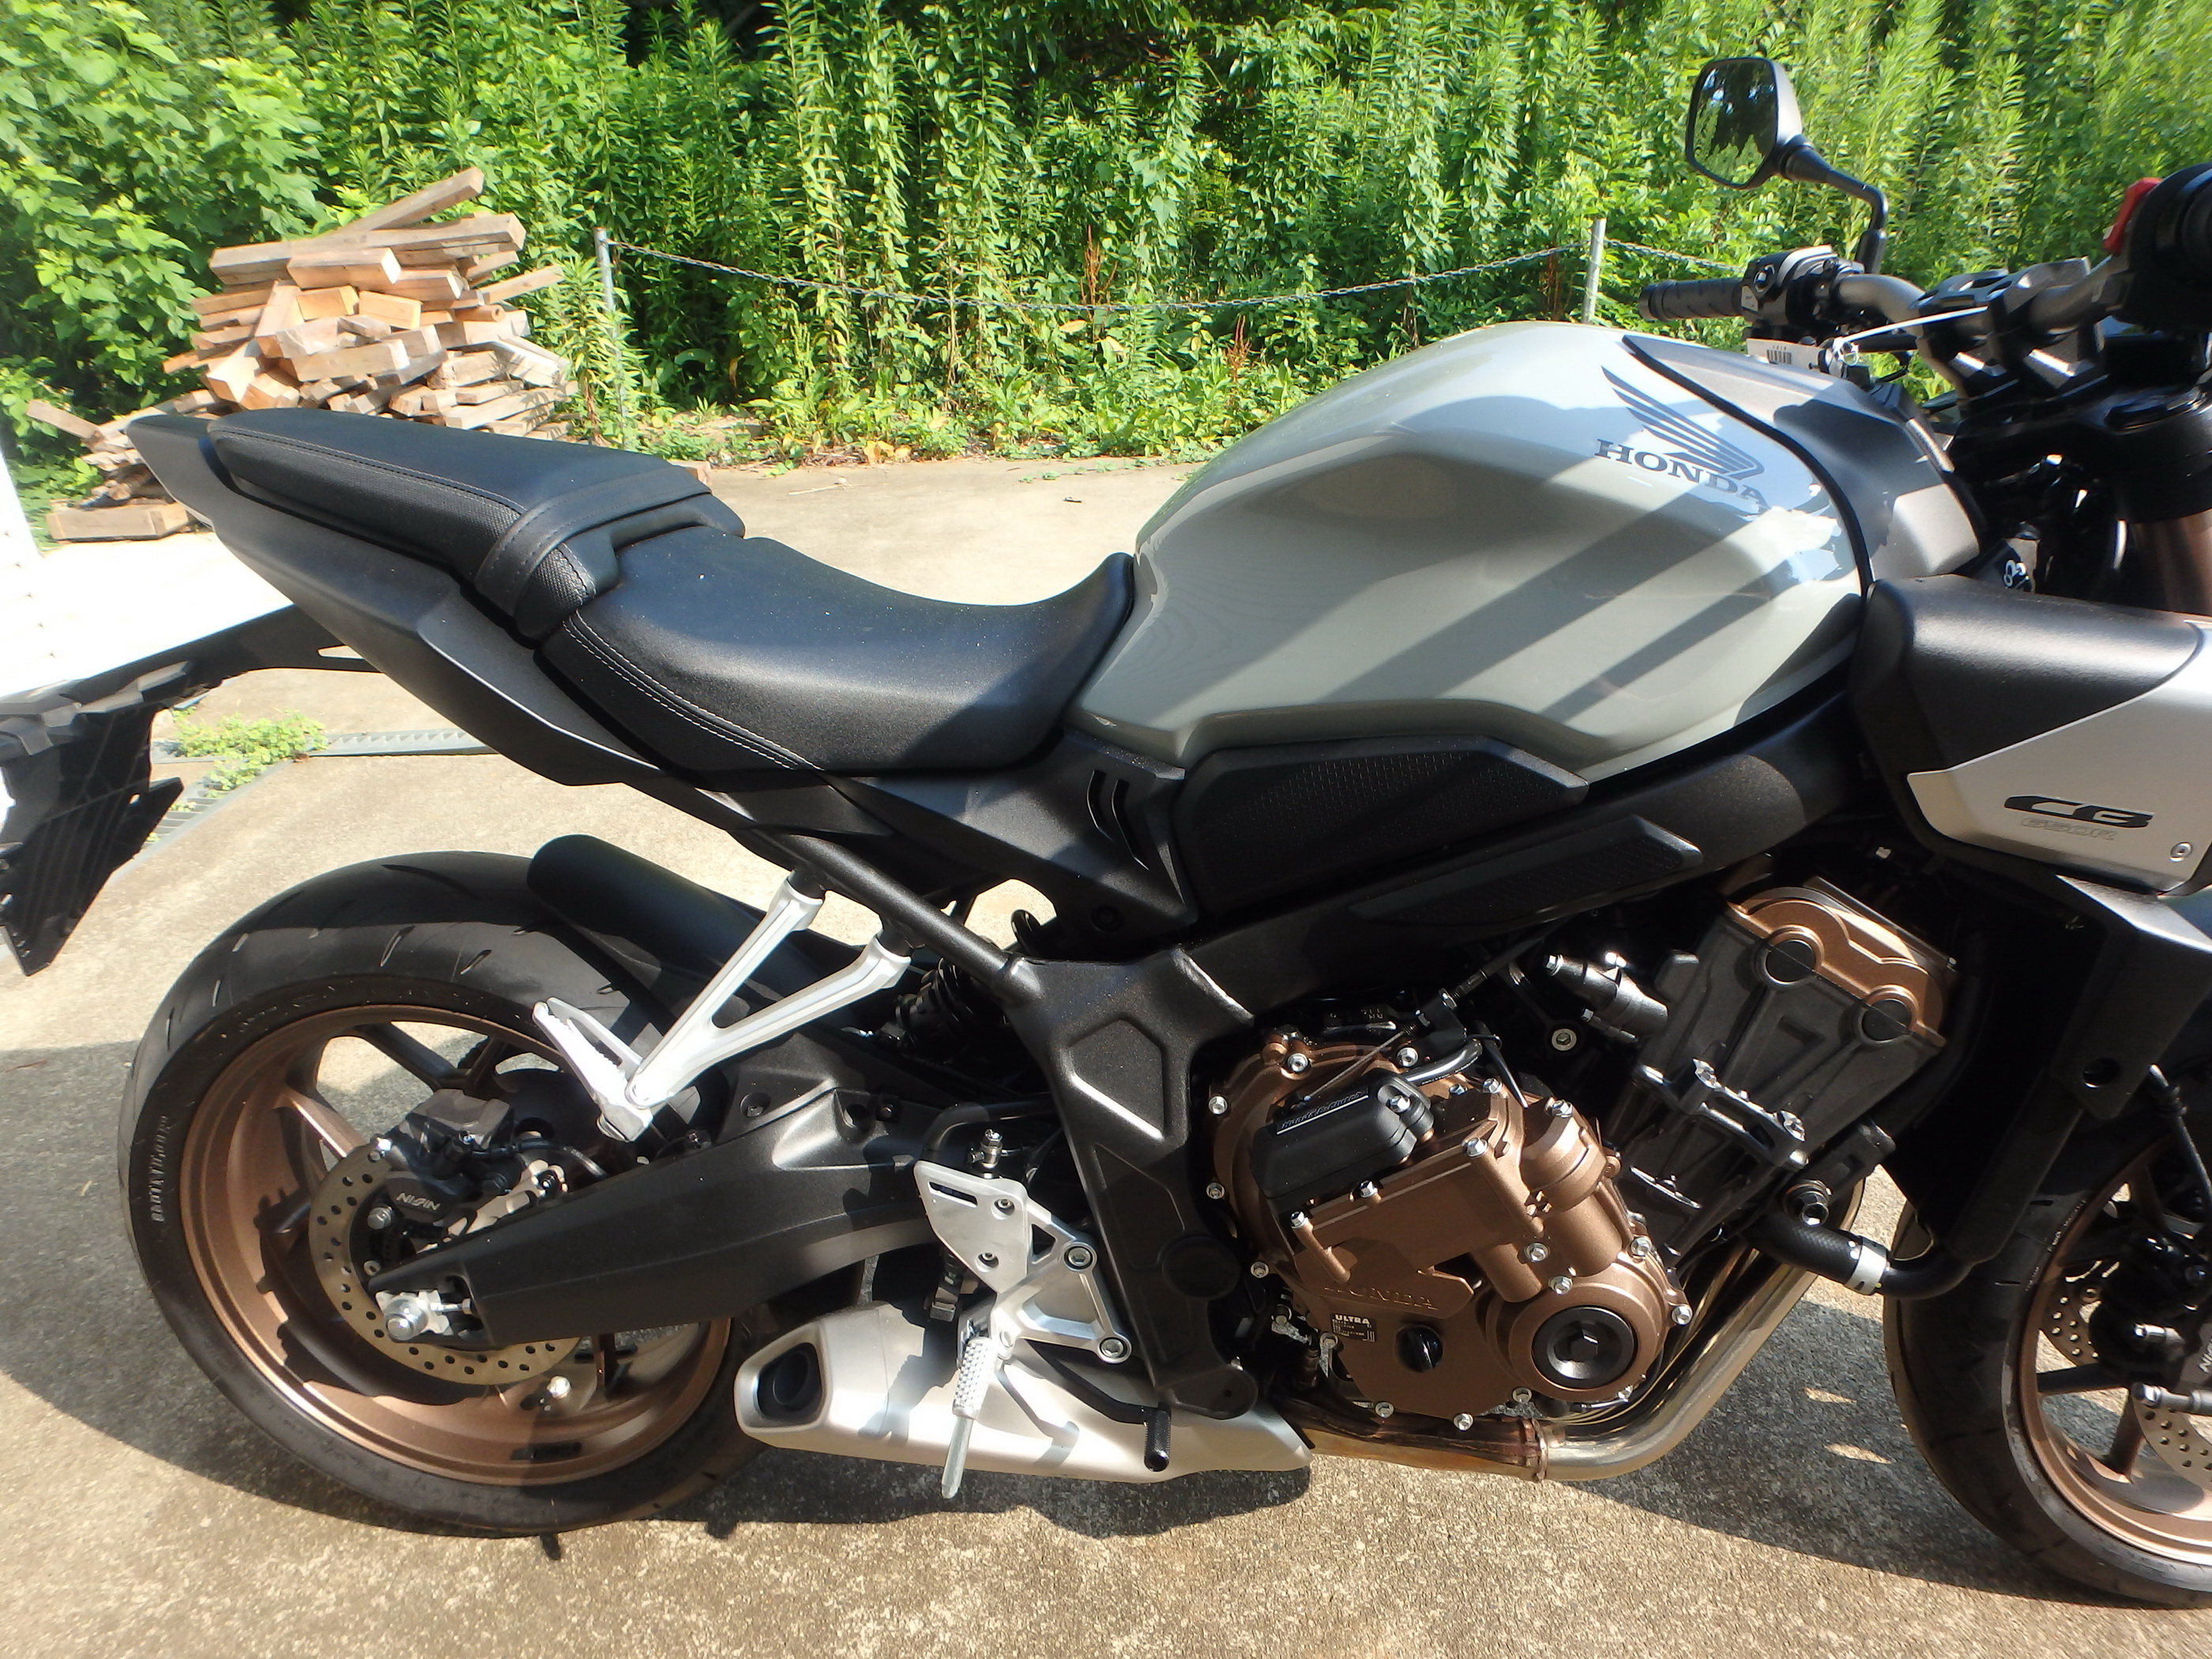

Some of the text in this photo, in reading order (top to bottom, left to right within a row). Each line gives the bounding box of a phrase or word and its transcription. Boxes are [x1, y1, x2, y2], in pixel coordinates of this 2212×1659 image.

[1594, 438, 1770, 511] HONDA
[2003, 795, 2154, 828] CB
[2022, 818, 2117, 841] 650R
[1335, 1314, 1370, 1325] ULTRA
